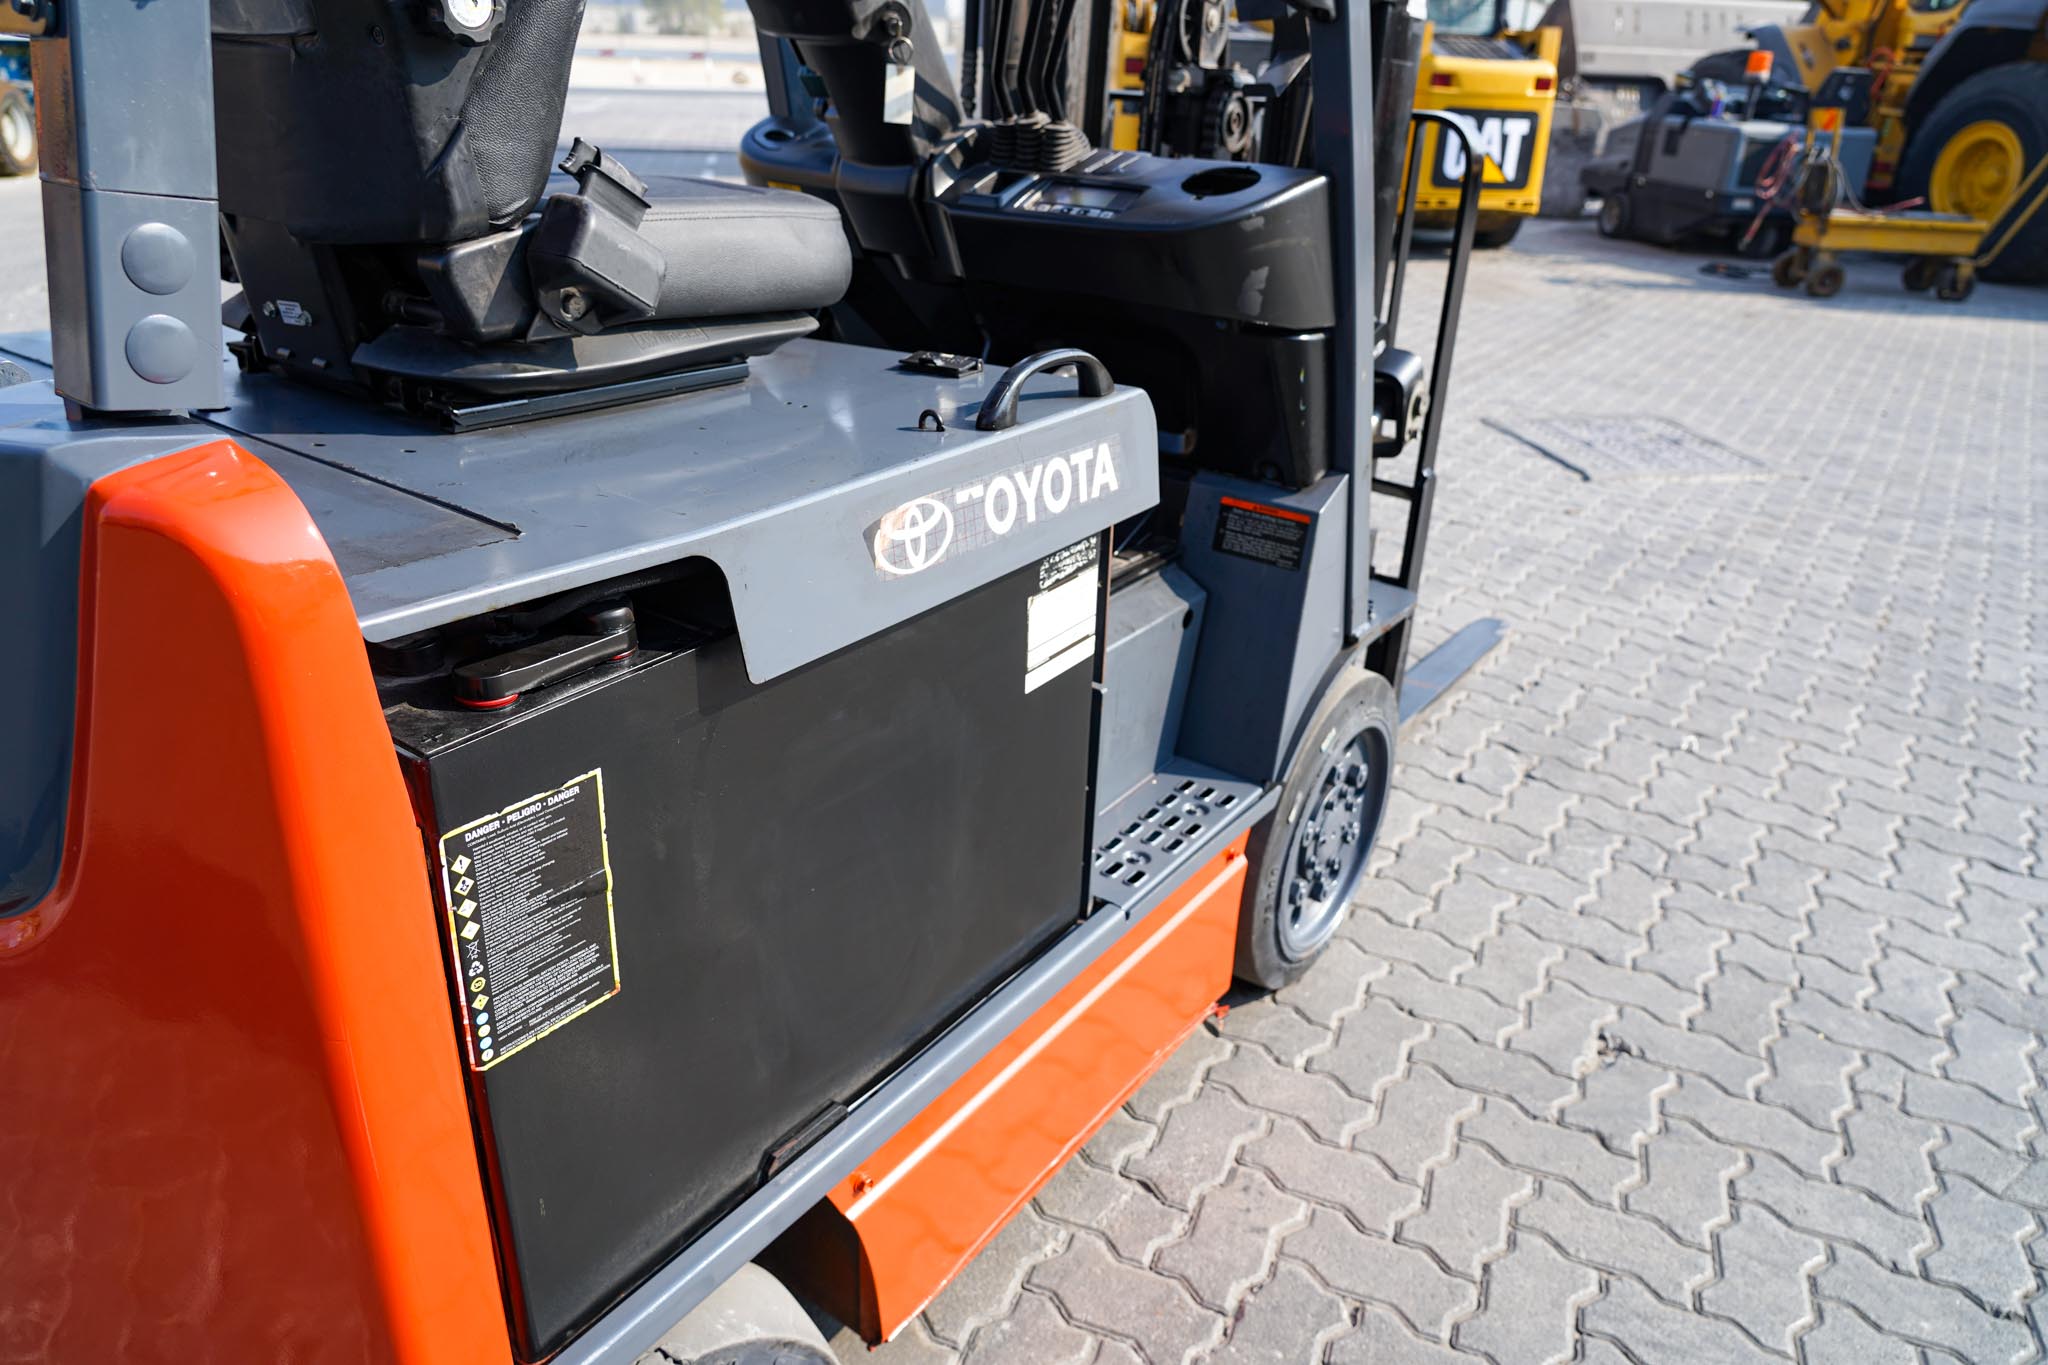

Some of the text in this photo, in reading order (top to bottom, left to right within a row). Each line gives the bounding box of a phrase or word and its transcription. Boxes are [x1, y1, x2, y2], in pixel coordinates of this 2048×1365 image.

[464, 784, 579, 843] DANGER PELIGRO DANGER
